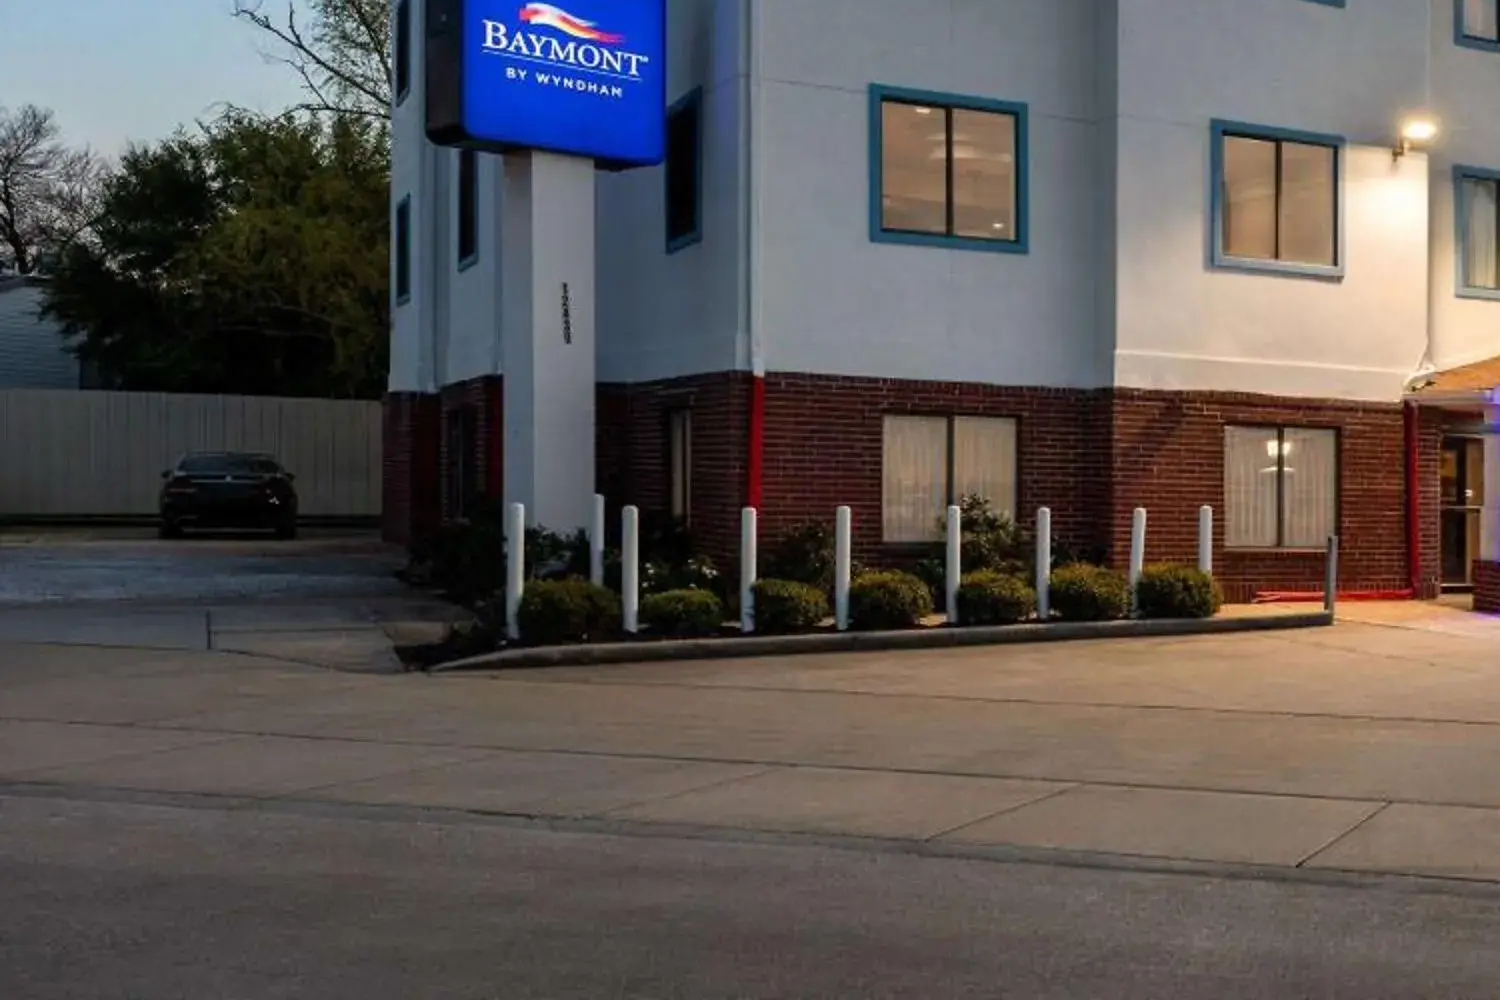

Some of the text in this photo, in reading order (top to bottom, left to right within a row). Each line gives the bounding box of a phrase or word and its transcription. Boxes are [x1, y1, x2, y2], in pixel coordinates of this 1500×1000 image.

[481, 19, 643, 77] BAYMONT
[505, 66, 623, 99] BY WYNDHAM
